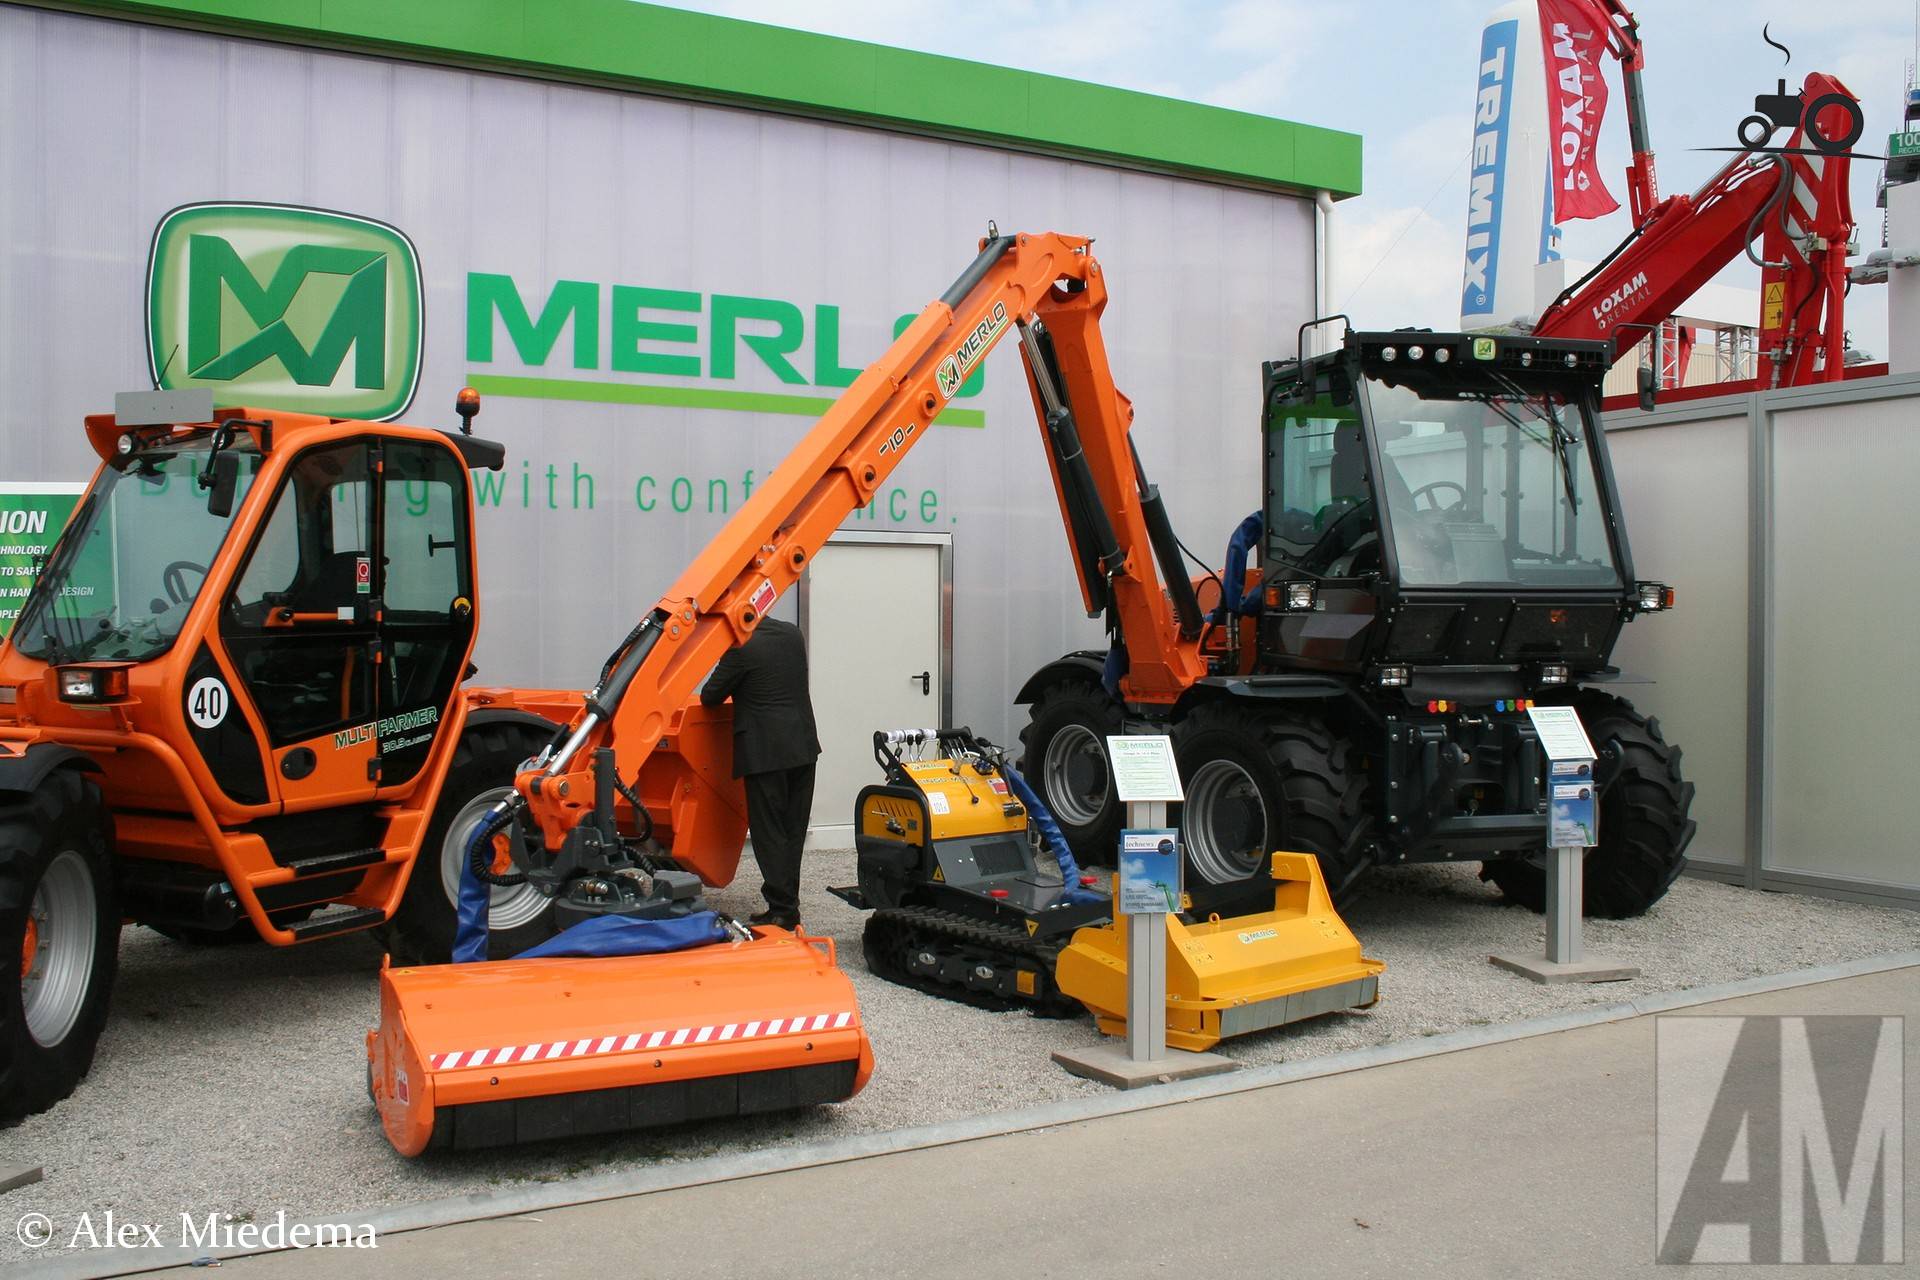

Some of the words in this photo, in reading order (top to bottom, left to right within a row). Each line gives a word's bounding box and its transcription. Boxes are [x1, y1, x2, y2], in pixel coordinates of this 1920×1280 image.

[1553, 22, 1584, 191] LOXAM
[1592, 271, 1648, 320] LOXAM
[1606, 286, 1651, 323] RENTAL
[956, 302, 1005, 366] MERLO
[473, 460, 595, 509] with
[636, 470, 957, 523] confce.
[2, 567, 14, 576] TO
[194, 687, 221, 719] 40
